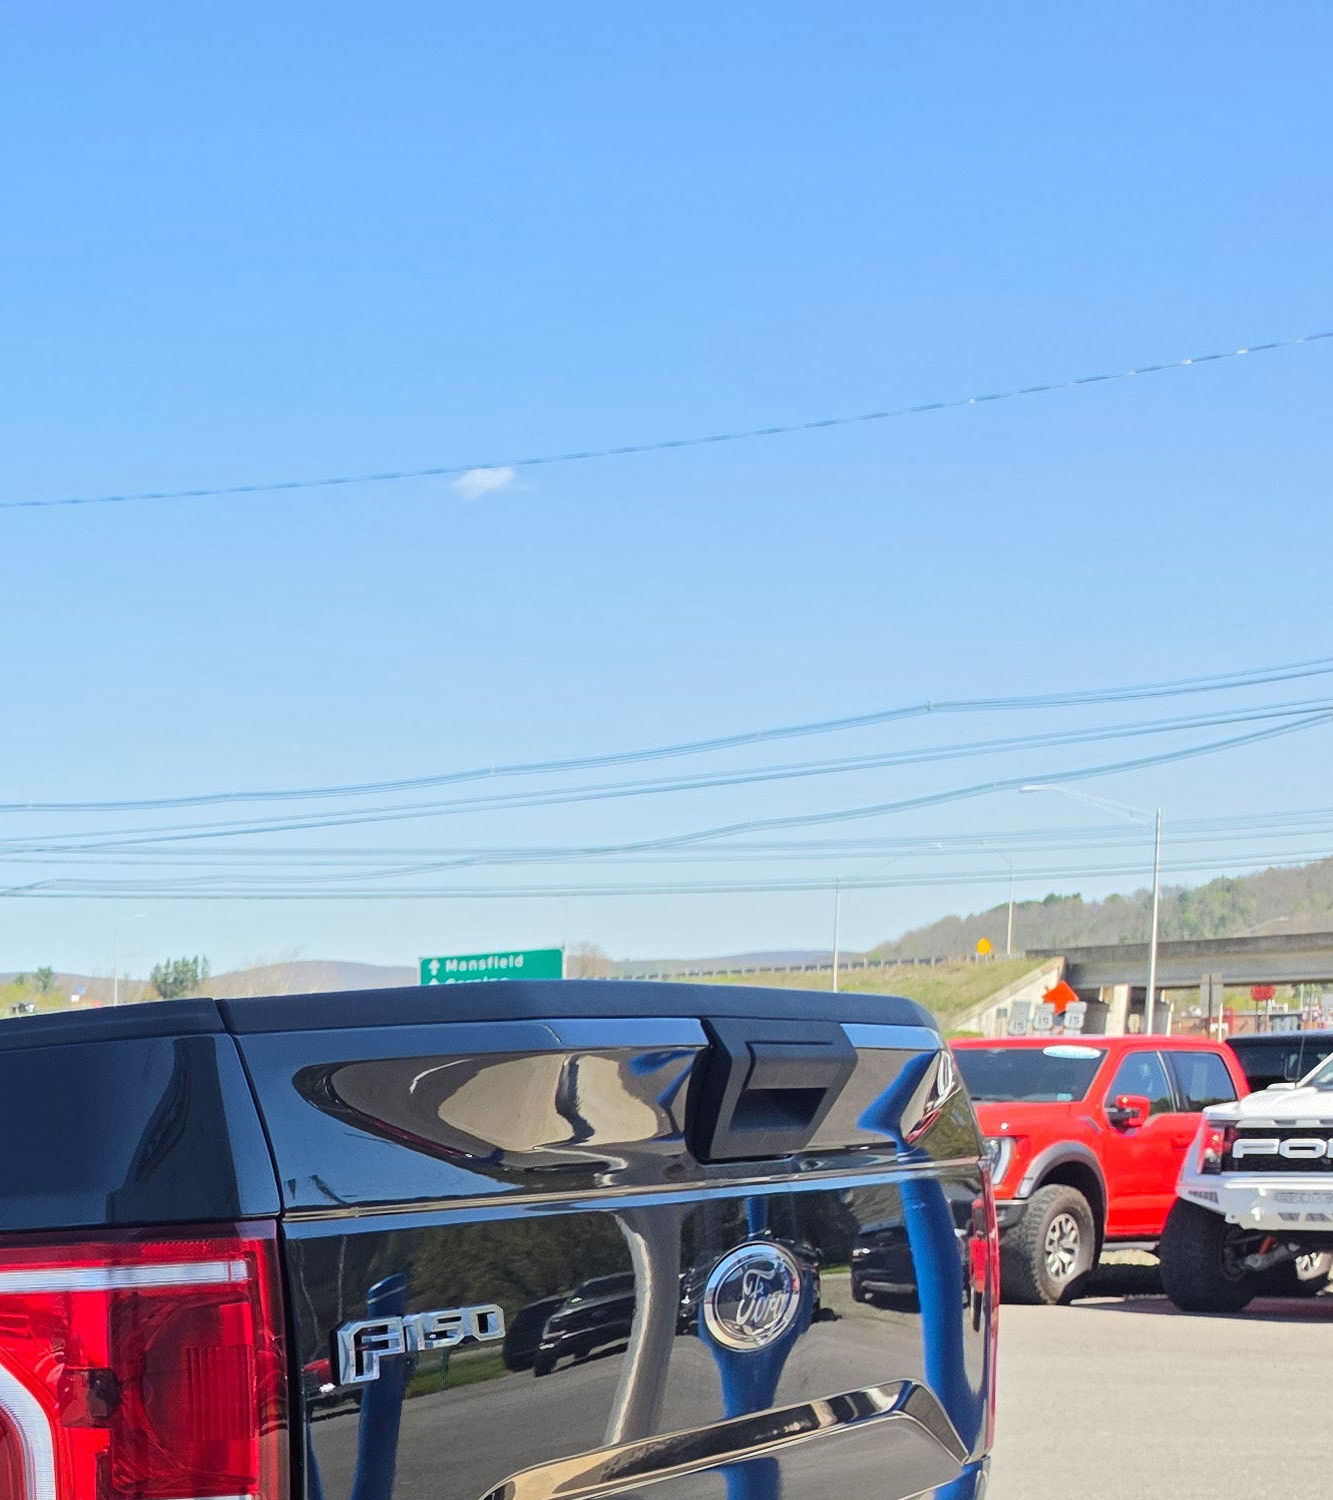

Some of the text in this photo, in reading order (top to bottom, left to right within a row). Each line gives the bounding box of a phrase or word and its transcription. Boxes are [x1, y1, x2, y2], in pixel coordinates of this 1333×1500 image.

[445, 955, 524, 972] Mansfield
[1232, 1138, 1333, 1159] FO
[736, 1268, 790, 1326] Ford
